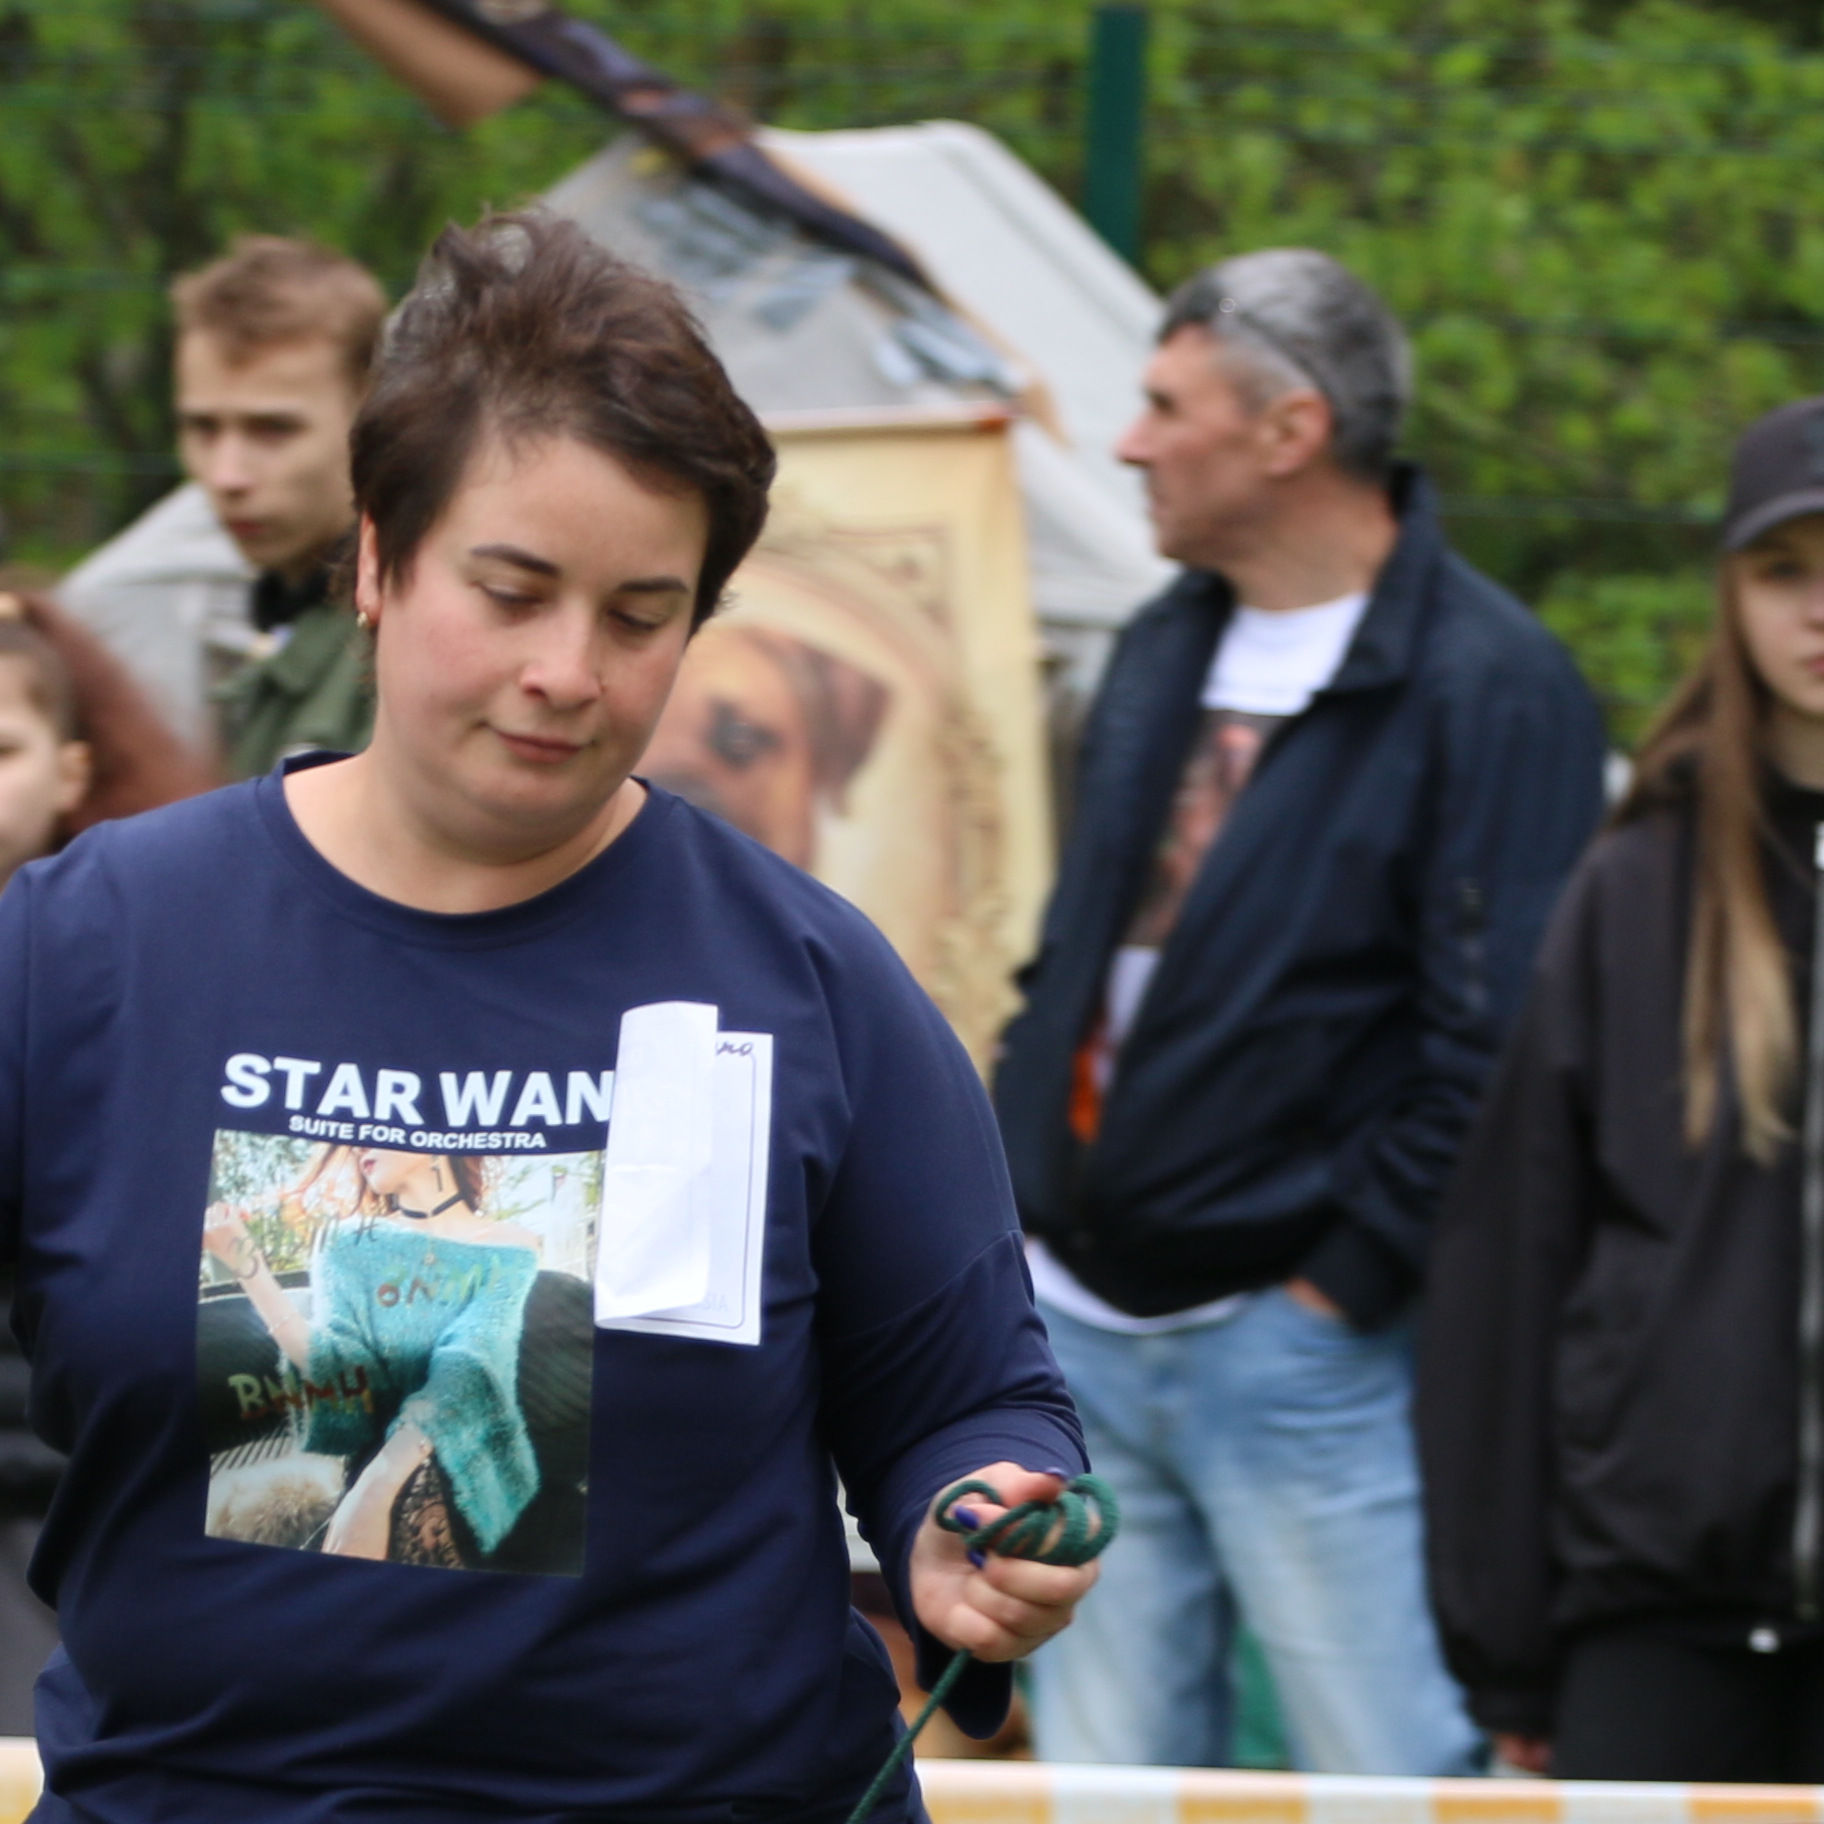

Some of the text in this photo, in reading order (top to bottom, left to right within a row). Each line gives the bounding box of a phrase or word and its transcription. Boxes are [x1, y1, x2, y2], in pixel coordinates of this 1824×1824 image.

[220, 1052, 615, 1127] STAR WAN
[289, 1114, 547, 1150] SUITE FOR ORCHESTRA
